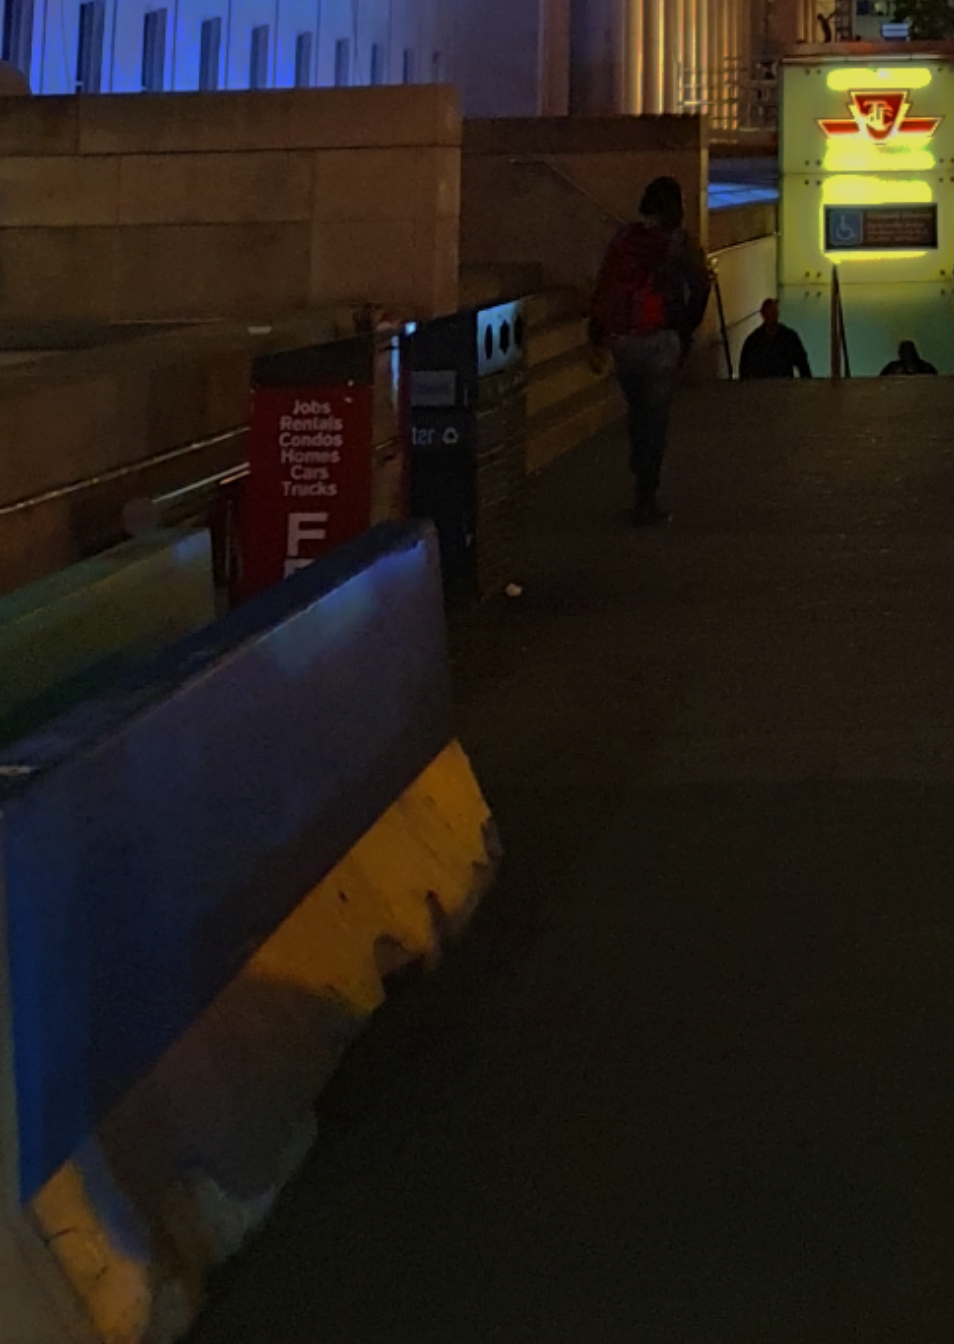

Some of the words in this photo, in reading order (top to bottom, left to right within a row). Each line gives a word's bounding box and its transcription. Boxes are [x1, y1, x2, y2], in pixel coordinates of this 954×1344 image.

[292, 400, 331, 415] Jobs
[279, 414, 344, 432] Rentals
[278, 433, 344, 448] Condos
[280, 449, 341, 464] Homes
[290, 466, 330, 481] Cars
[282, 481, 338, 497] Trucks
